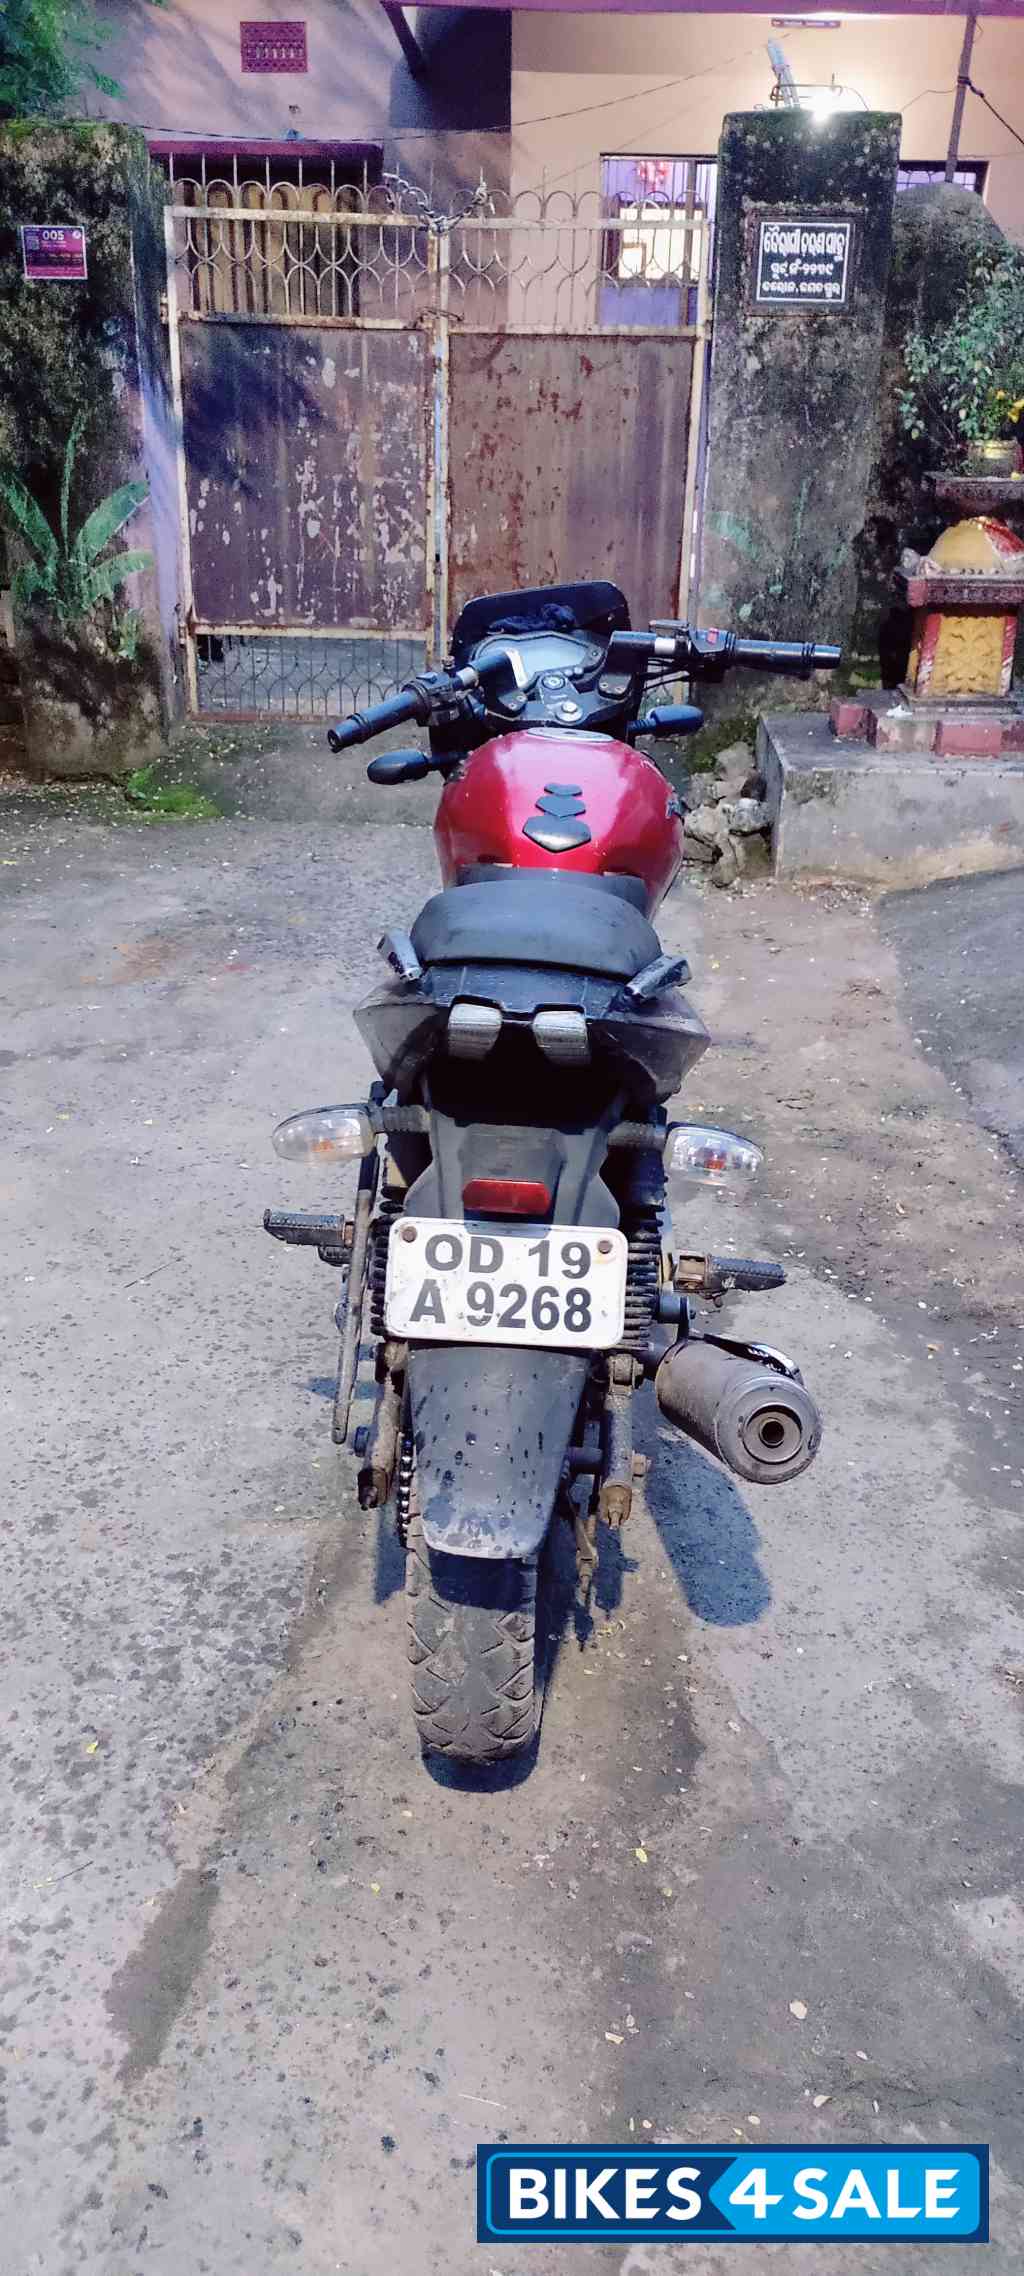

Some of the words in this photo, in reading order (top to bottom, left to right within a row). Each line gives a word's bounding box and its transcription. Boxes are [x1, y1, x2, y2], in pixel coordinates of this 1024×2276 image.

[42, 230, 65, 241] 005
[801, 232, 826, 257] ଚରଣ
[826, 232, 845, 262] ସାହୁ
[425, 1233, 504, 1274] OD
[528, 1239, 592, 1280] 19
[408, 1278, 447, 1324] A
[466, 1280, 593, 1333] 9268
